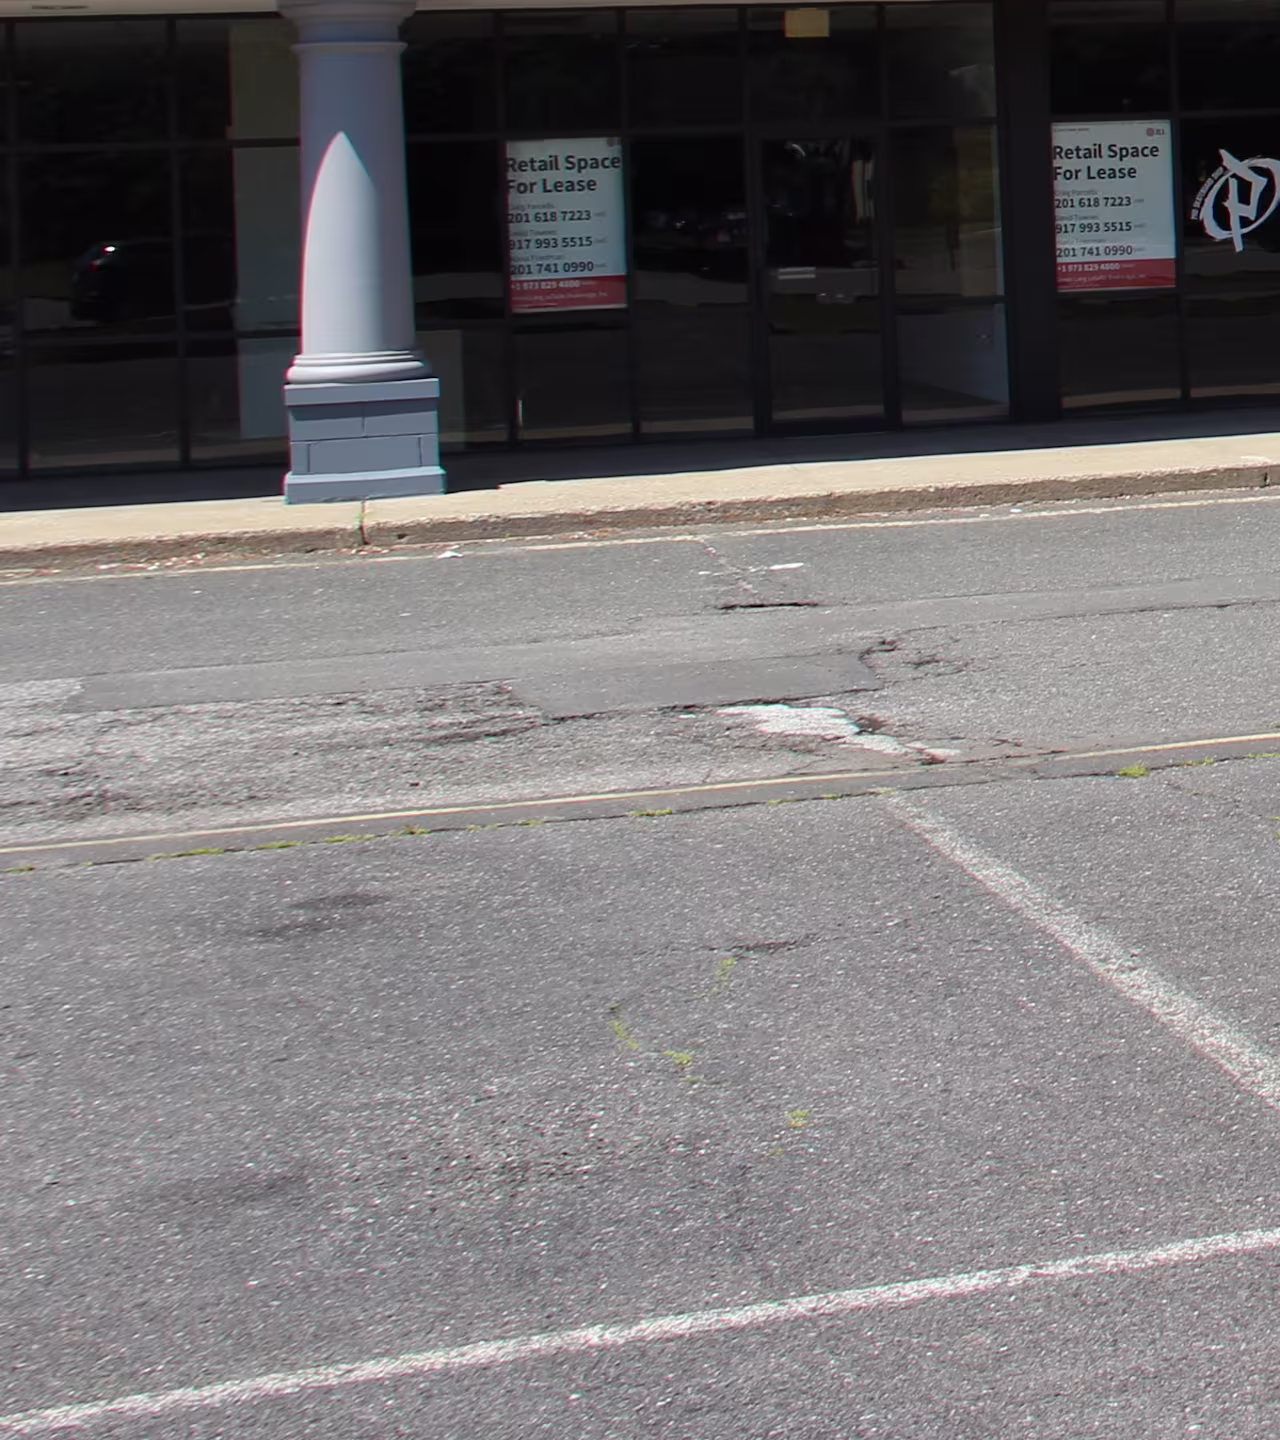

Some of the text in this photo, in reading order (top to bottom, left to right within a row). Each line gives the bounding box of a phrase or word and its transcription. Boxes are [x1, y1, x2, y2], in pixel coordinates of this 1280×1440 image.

[1053, 143, 1160, 162] Retail Space
[506, 153, 621, 173] Retail Space
[1054, 165, 1137, 182] For Lease
[507, 178, 598, 194] For Lease
[1055, 198, 1075, 209] 201
[1078, 197, 1100, 208] 618
[1103, 196, 1132, 207] 7223
[507, 213, 531, 224] 201
[534, 211, 557, 223] 618
[561, 210, 592, 222] 7223
[1055, 223, 1076, 235] 917
[1079, 222, 1101, 233] 993
[1104, 221, 1132, 232] 5515
[509, 239, 532, 251] 917
[535, 238, 558, 249] 993
[561, 237, 593, 248] 5515
[1056, 247, 1077, 258] 201
[1081, 247, 1101, 257] 741
[1104, 245, 1133, 256] 0990
[510, 264, 533, 276] 201
[536, 263, 559, 274] 741
[563, 261, 594, 272] 0990
